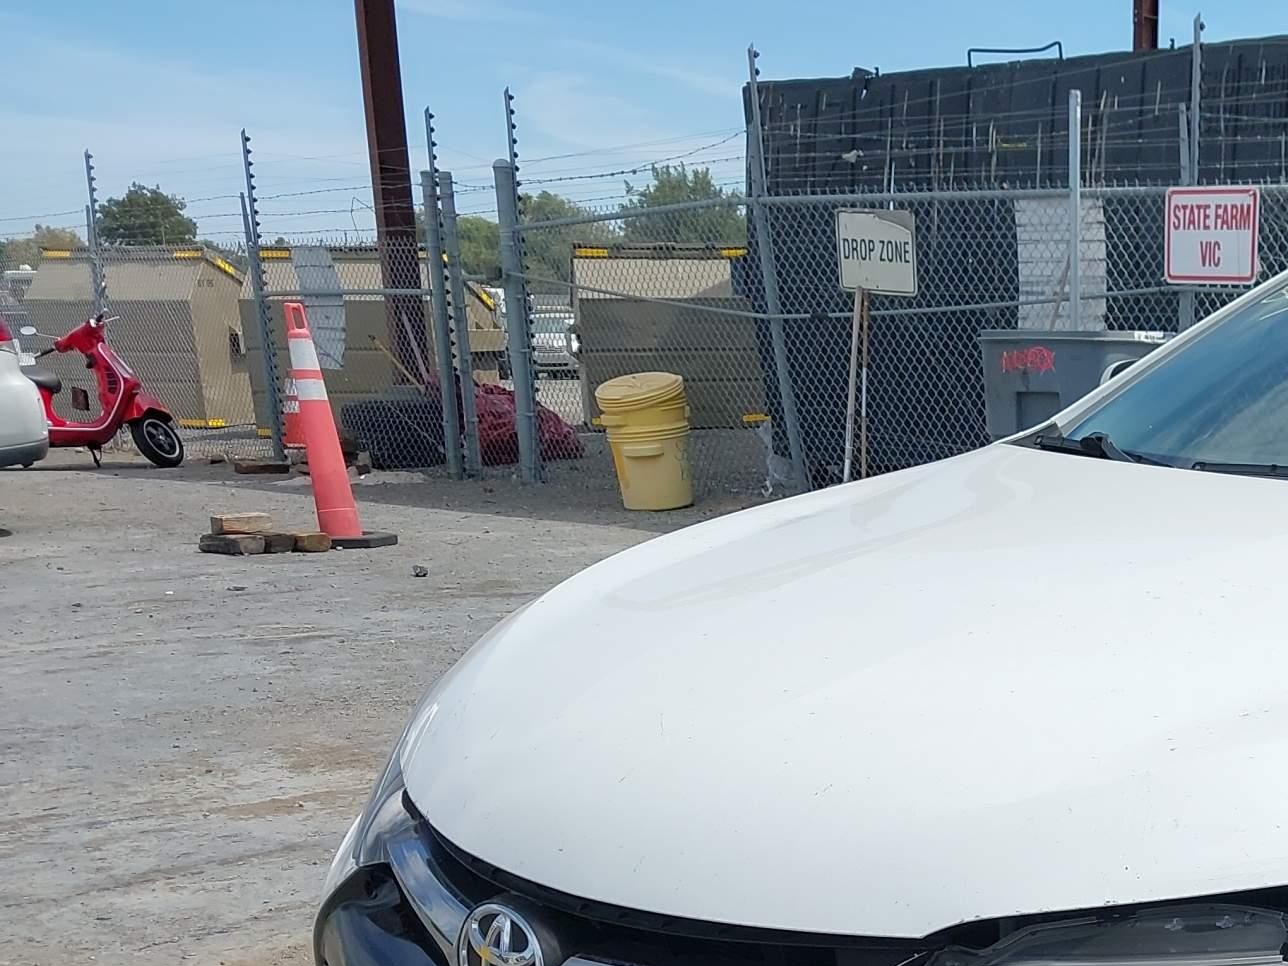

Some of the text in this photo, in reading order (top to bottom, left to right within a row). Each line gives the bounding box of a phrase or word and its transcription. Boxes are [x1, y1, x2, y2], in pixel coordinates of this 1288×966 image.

[1173, 203, 1251, 231] STATE FARM
[842, 238, 911, 264] DROP ZONE
[1200, 240, 1221, 268] VIC
